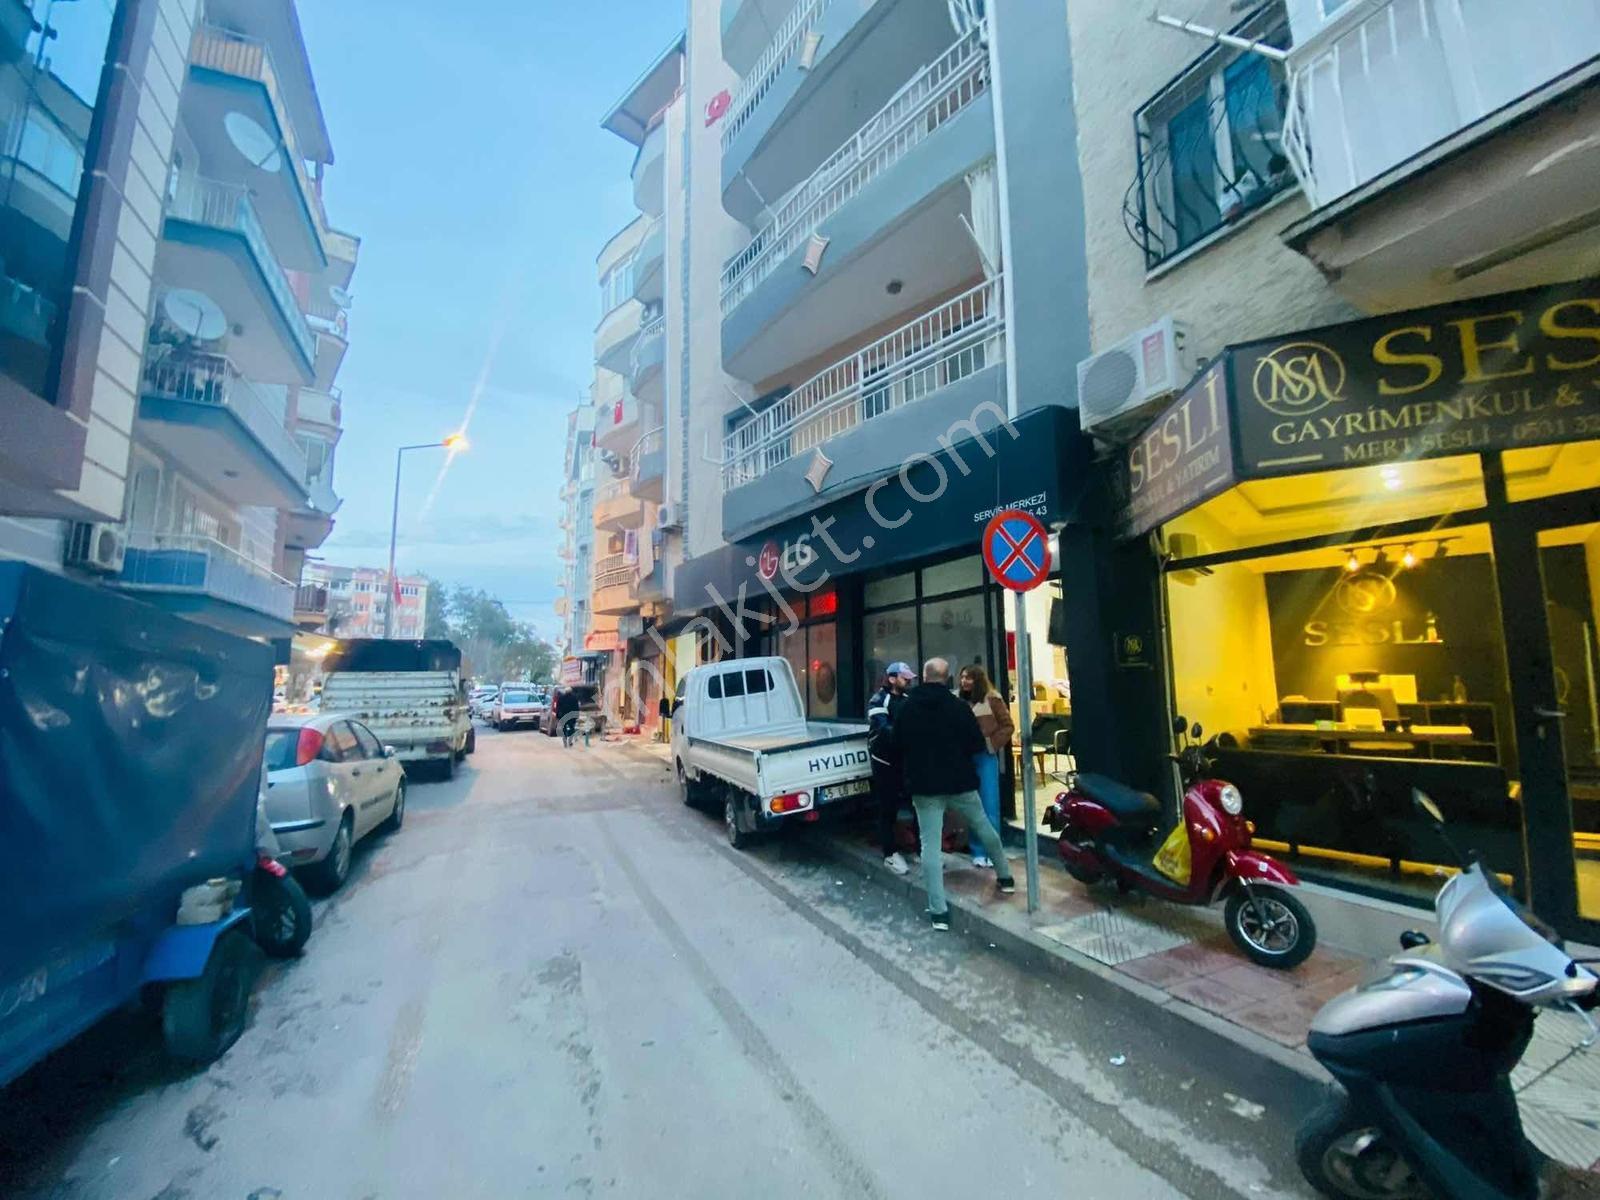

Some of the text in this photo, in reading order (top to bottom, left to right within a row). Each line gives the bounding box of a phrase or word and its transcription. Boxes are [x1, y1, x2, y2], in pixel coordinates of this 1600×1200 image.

[1130, 369, 1219, 493] SESLİ
[1272, 387, 1550, 445] GAYRİMENKUL
[1343, 434, 1412, 462] MERT
[783, 533, 812, 570] LG
